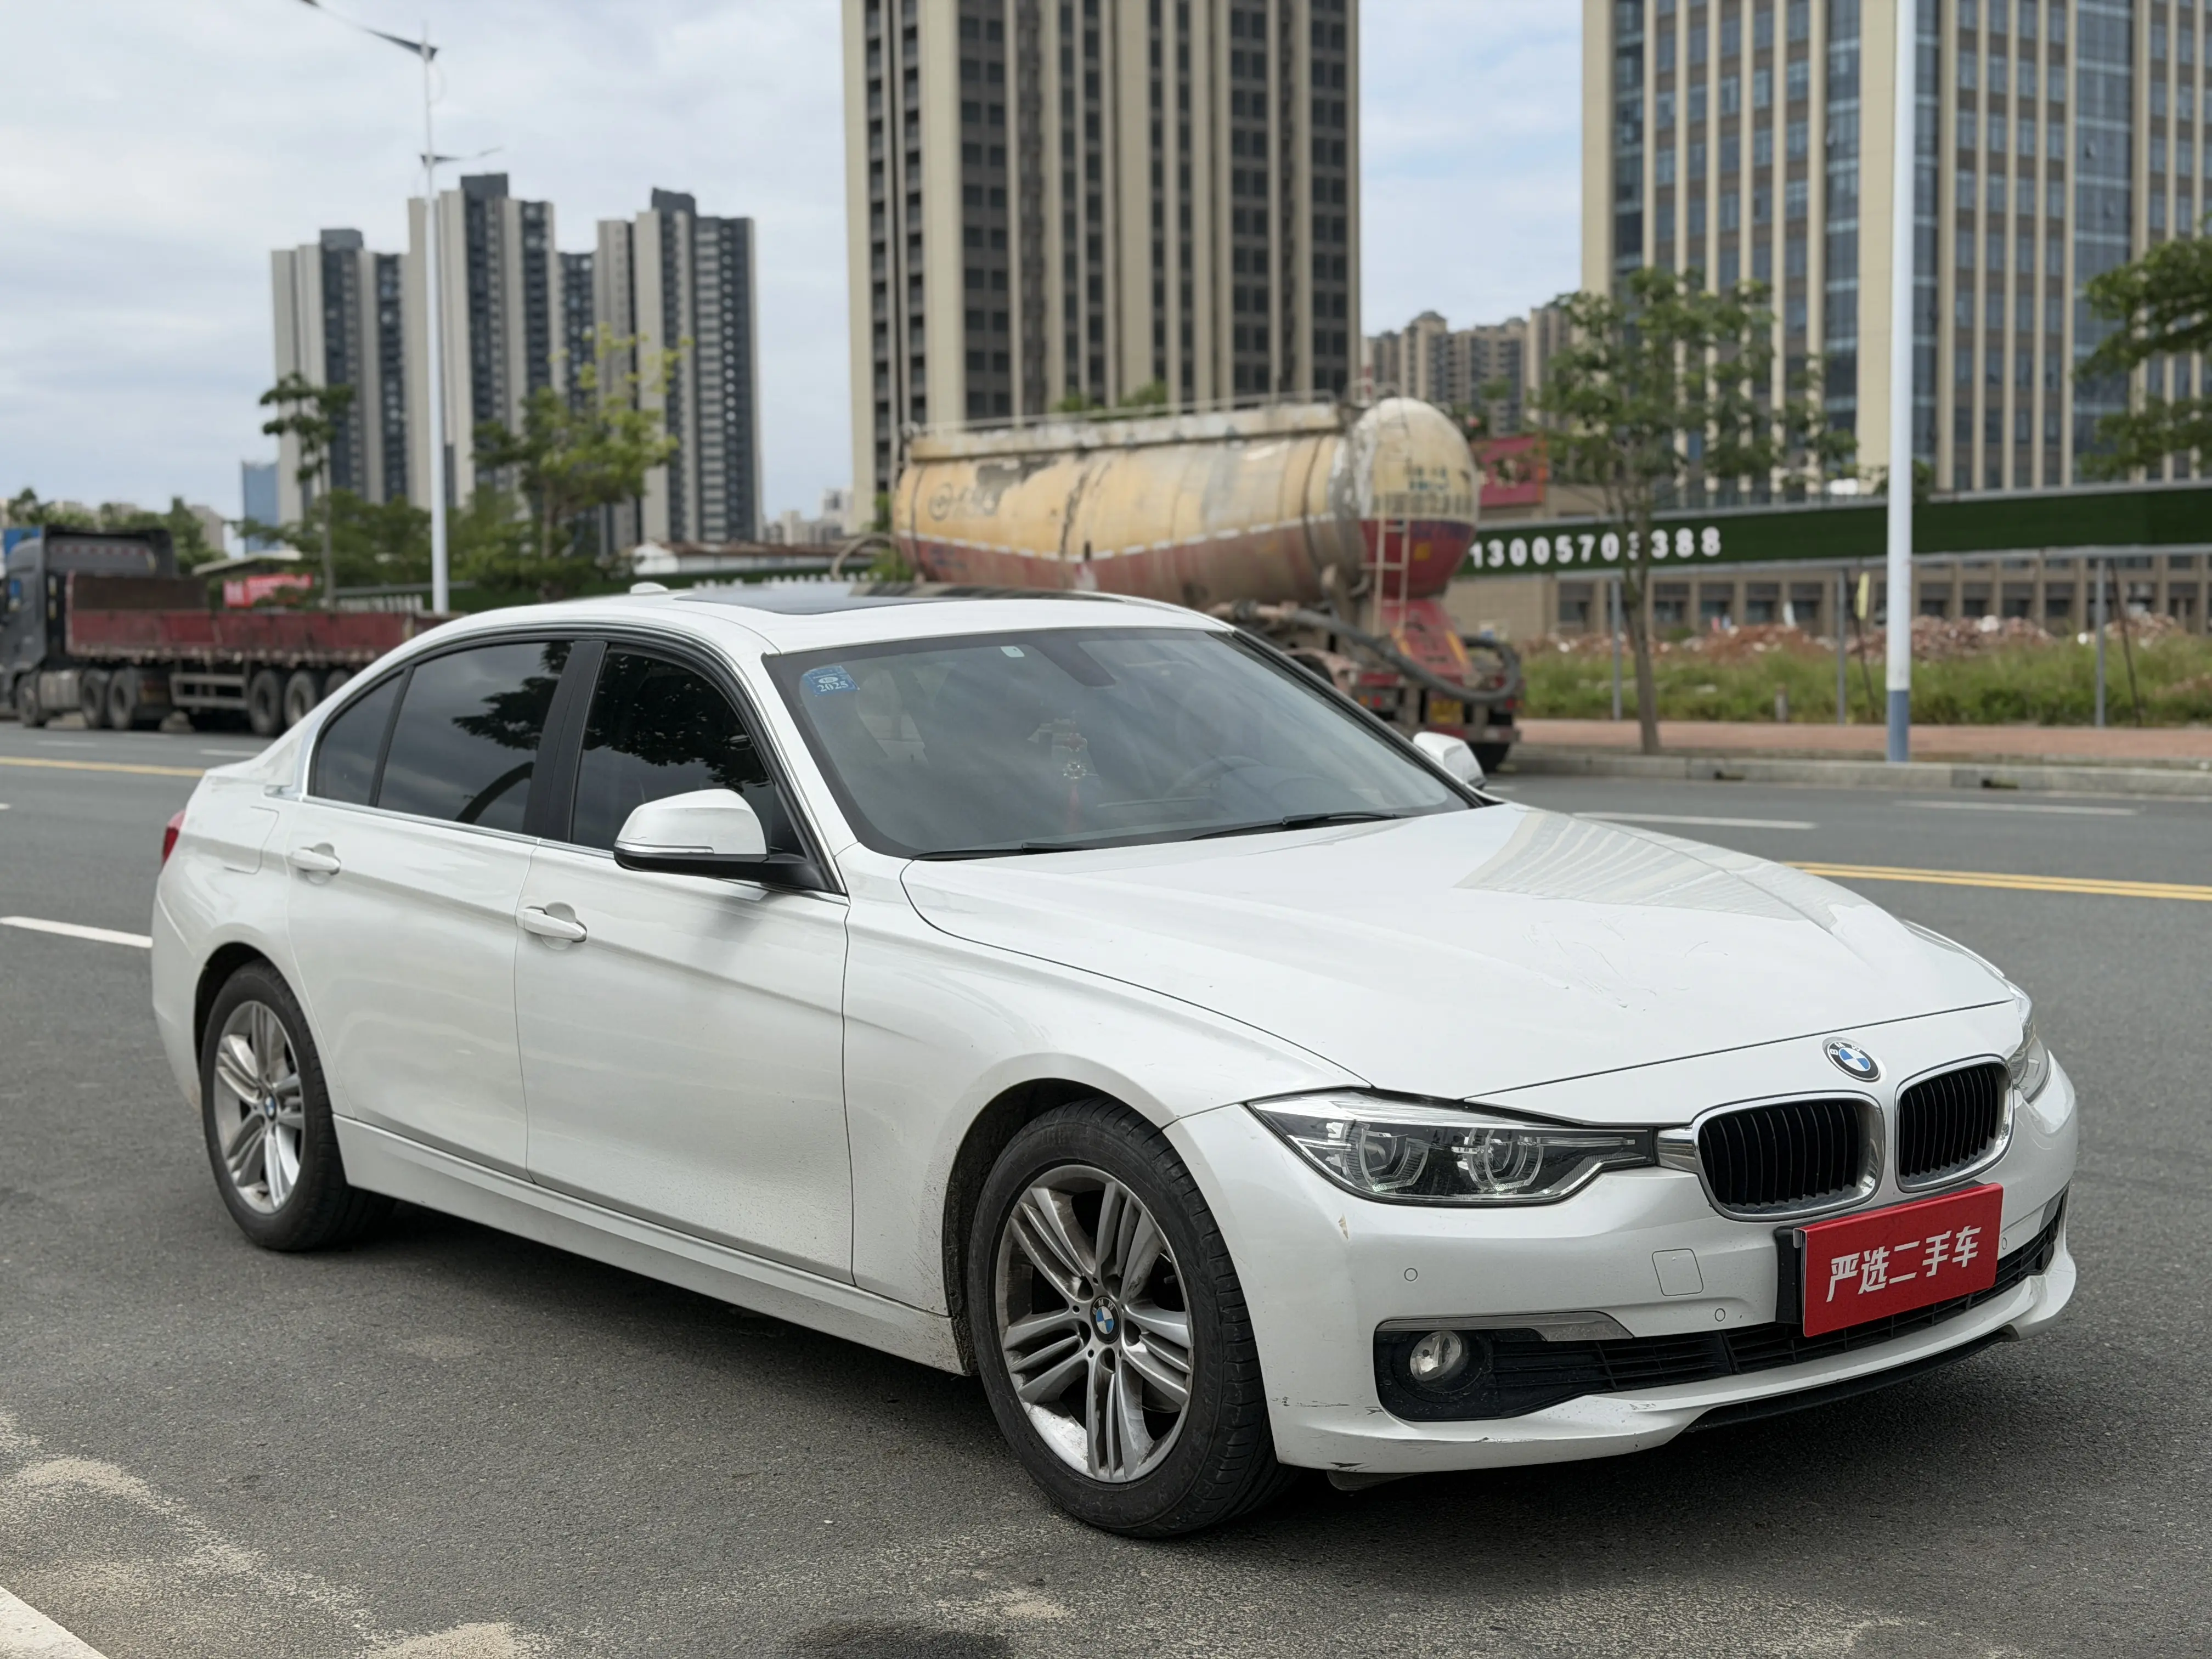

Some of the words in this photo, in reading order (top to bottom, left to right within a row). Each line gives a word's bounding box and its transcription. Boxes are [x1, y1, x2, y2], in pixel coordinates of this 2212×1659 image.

[817, 680, 849, 692] 2025
[1826, 1225, 1982, 1302] 严选二手车
[1092, 1299, 1115, 1316] BMW
